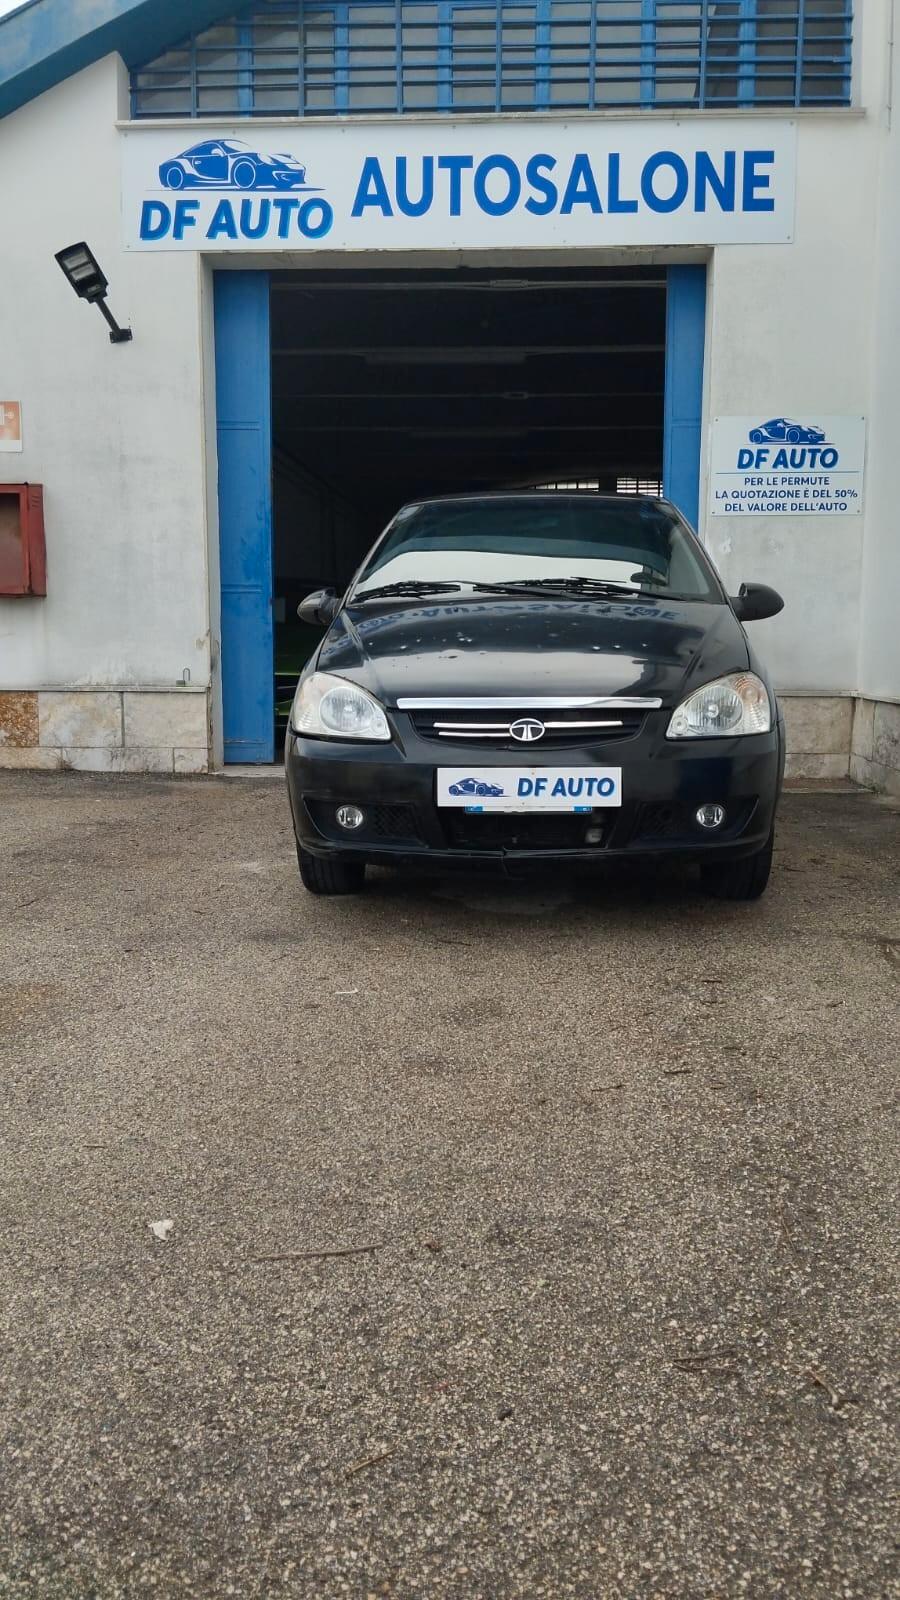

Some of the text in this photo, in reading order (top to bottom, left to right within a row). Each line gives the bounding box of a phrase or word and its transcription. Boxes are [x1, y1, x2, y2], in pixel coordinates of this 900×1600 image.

[351, 151, 775, 217] AUTOSALONE
[140, 198, 334, 241] DF AUTO
[737, 447, 839, 470] DF AUTO
[744, 476, 830, 486] PER LE PERMUTE
[715, 490, 728, 499] LA
[731, 489, 801, 499] QUOTAZIONE
[812, 489, 832, 498] DEL
[835, 489, 858, 498] 50%
[724, 503, 744, 512] DEL
[748, 503, 787, 512] VALORE
[517, 777, 615, 797] DF AUTO
